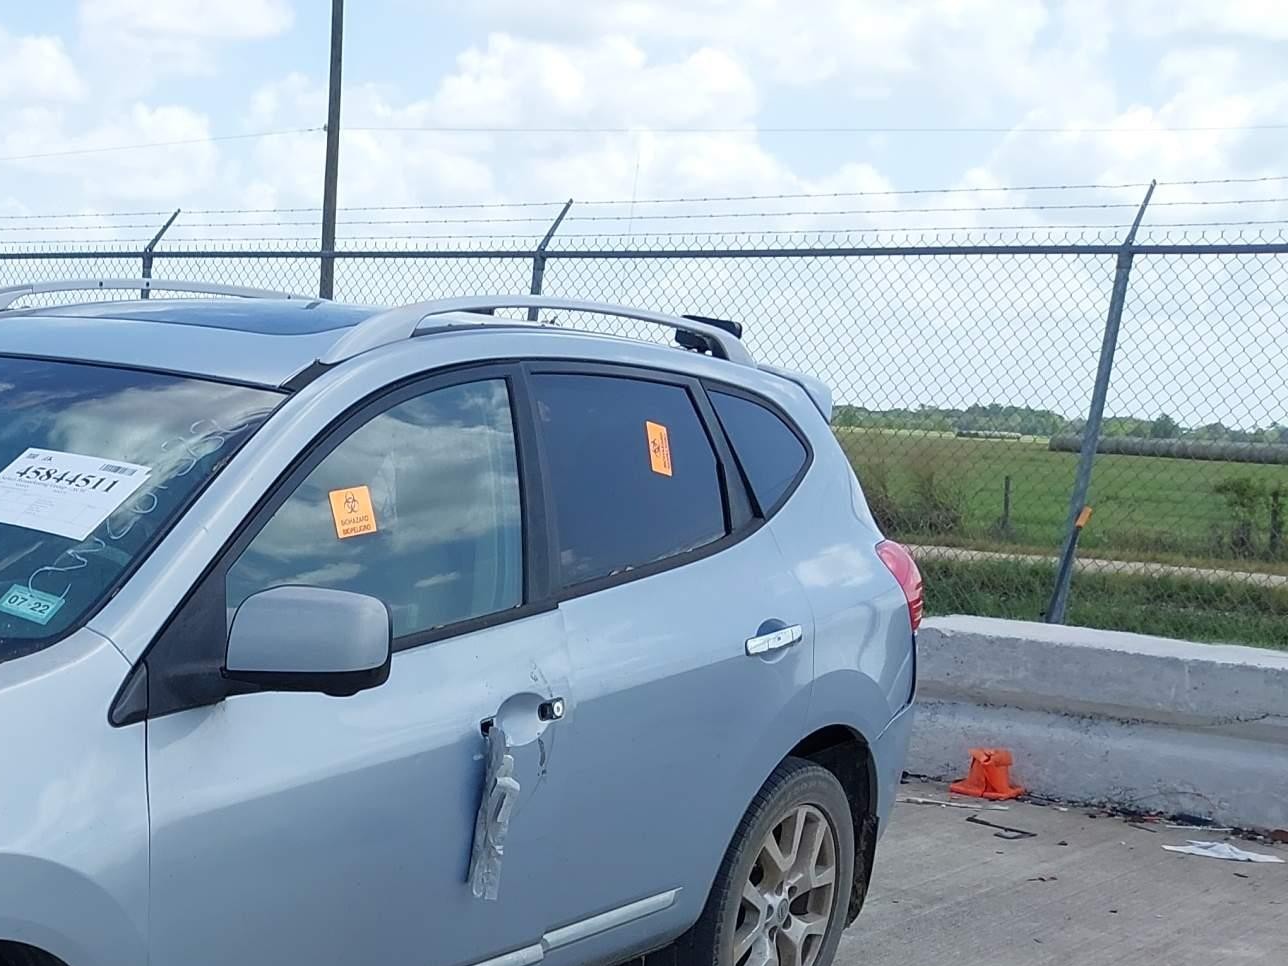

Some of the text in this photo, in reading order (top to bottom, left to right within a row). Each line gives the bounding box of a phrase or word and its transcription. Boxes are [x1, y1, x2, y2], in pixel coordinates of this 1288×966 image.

[15, 465, 120, 493] 45844511
[7, 594, 50, 615] 07 22
